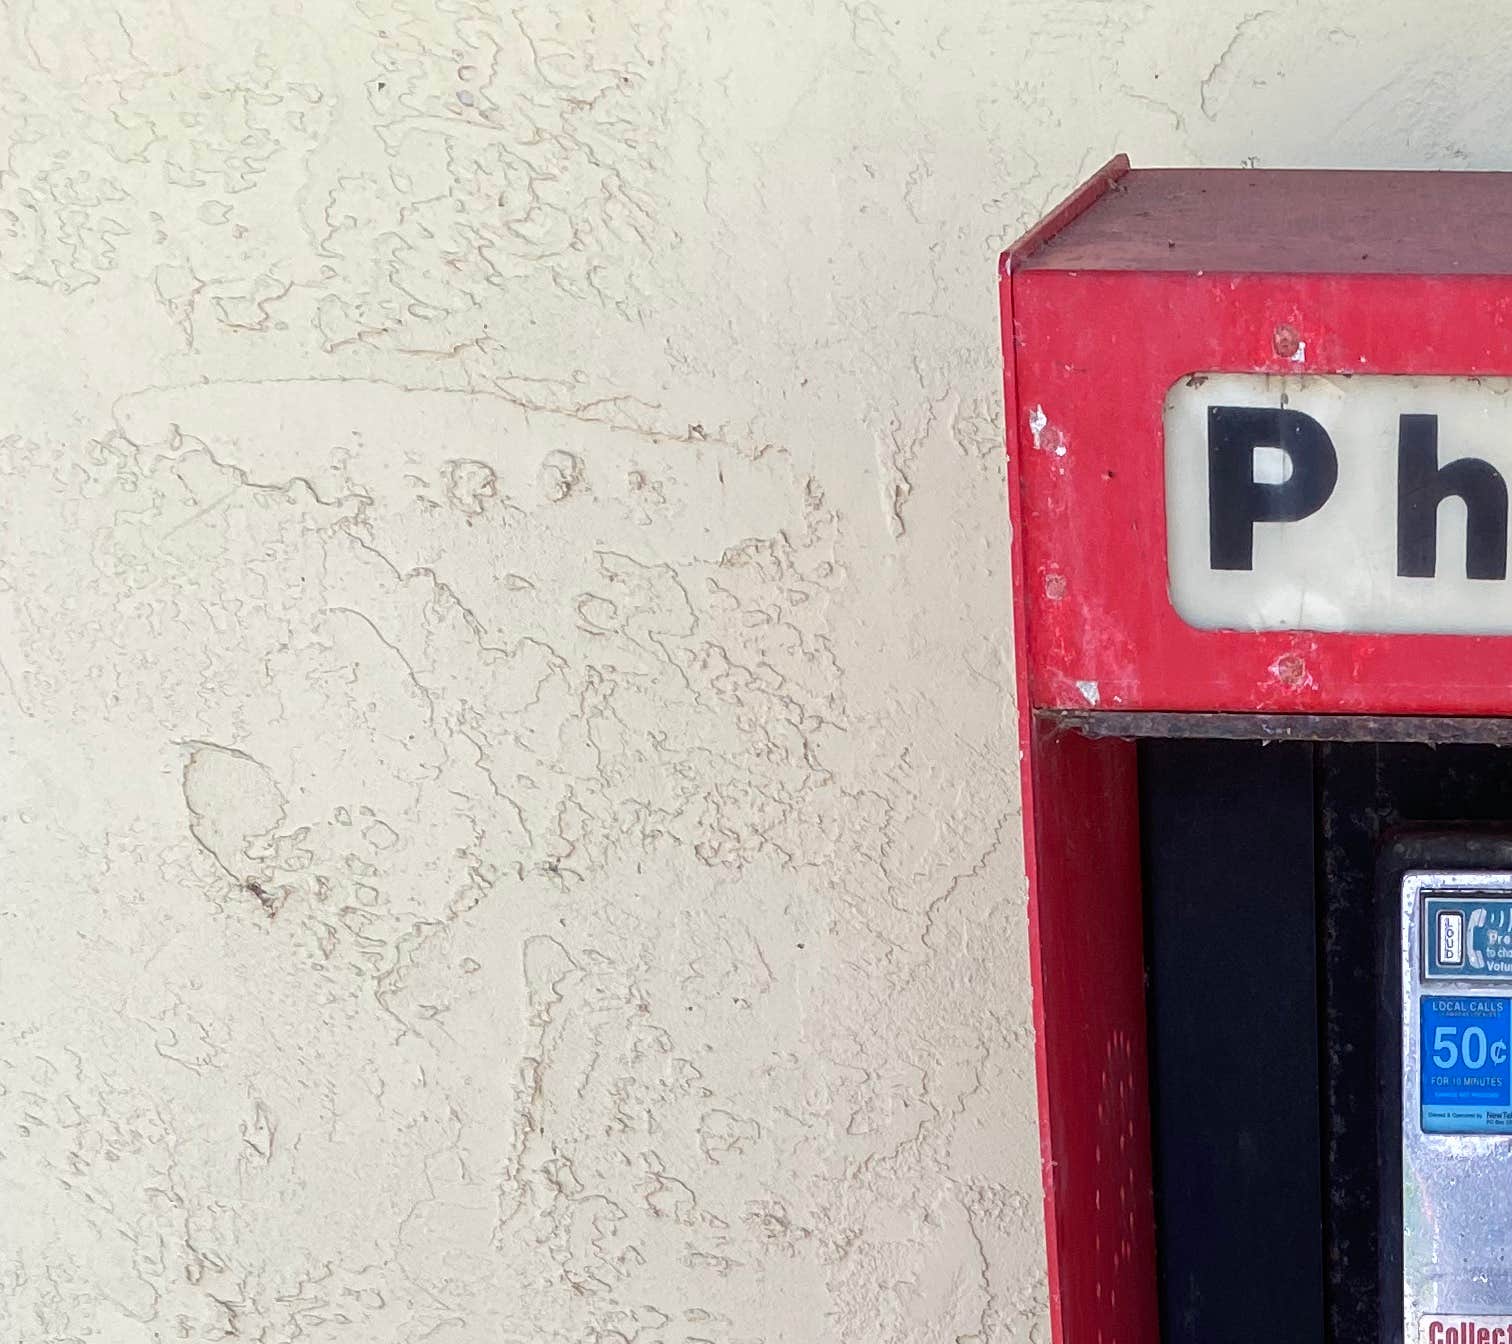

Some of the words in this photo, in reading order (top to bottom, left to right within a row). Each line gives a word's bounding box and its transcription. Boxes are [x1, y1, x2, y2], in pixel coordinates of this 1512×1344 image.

[1445, 917, 1454, 959] LOUD
[1485, 946, 1496, 958] to
[1432, 1001, 1467, 1012] LOCAL
[1469, 1001, 1504, 1012] CALLS
[1431, 1076, 1449, 1086] FOR
[1463, 1077, 1503, 1087] MINUTES
